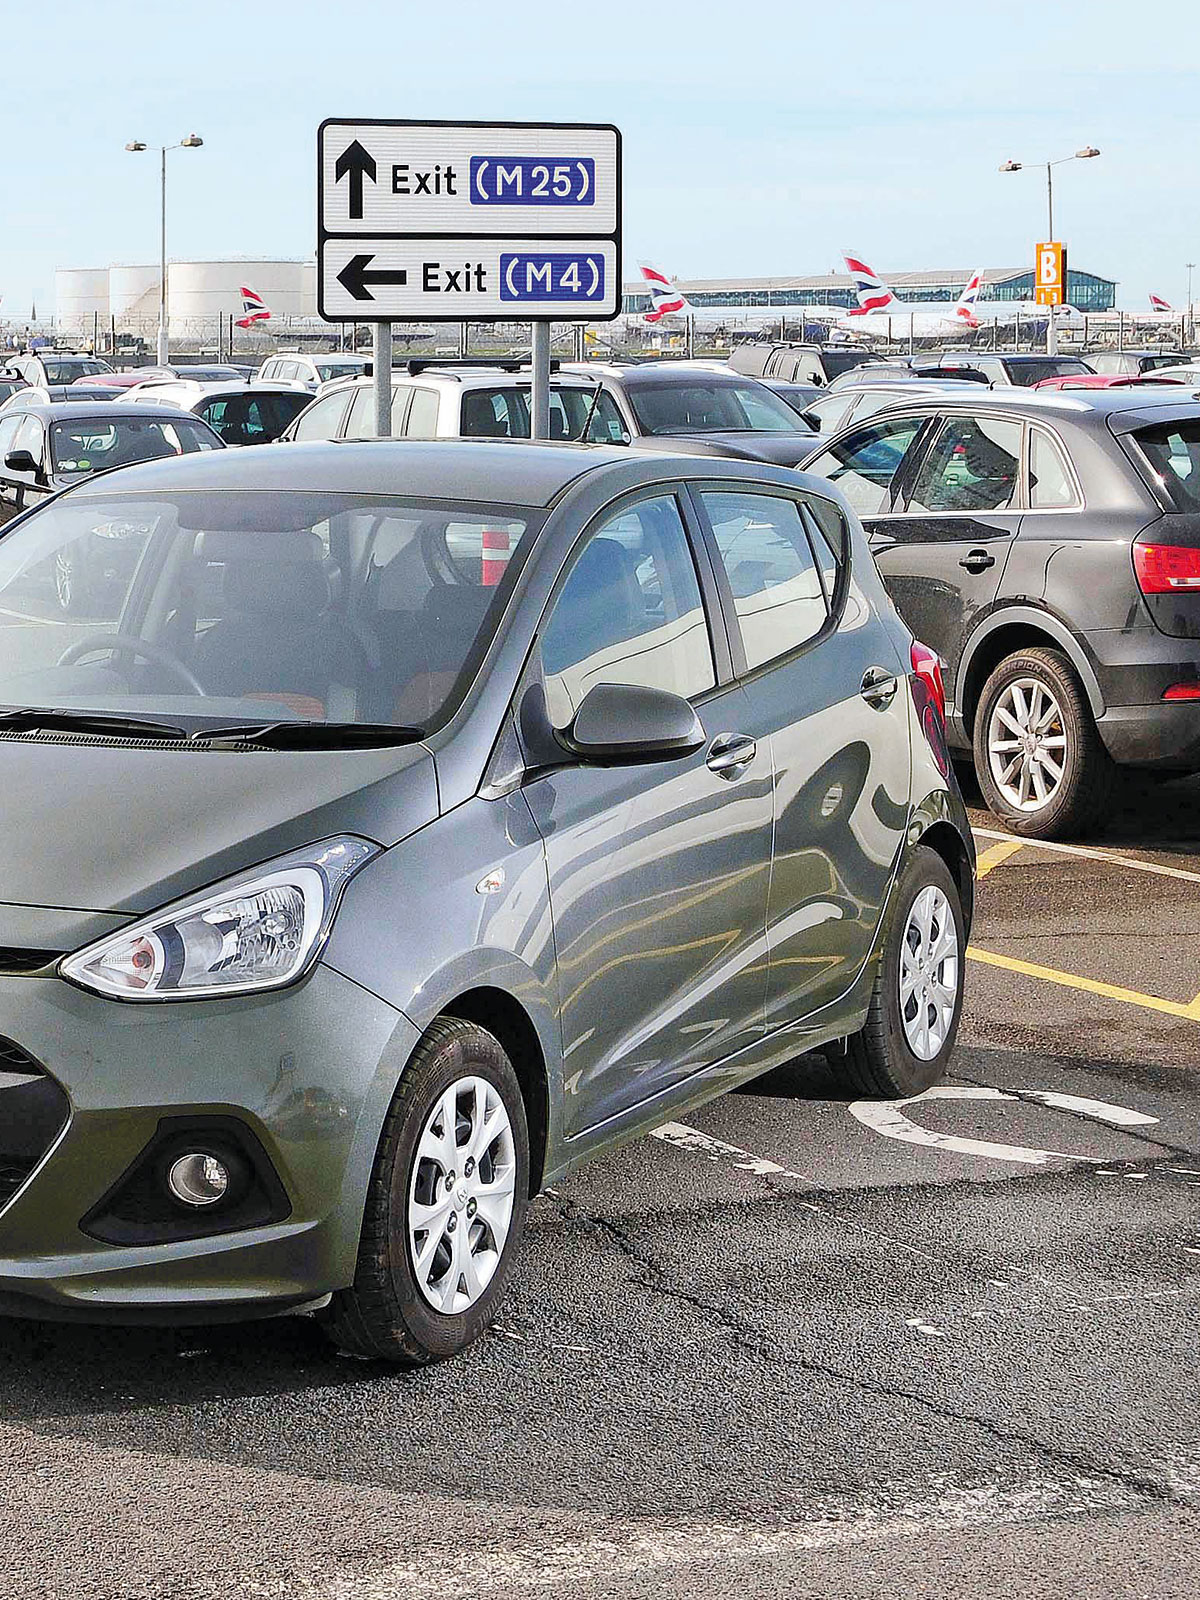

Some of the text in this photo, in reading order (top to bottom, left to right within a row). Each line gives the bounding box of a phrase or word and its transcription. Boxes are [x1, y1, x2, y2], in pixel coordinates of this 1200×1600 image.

[391, 164, 458, 196] Exit
[422, 262, 488, 293] Exit
[1040, 250, 1057, 284] B
